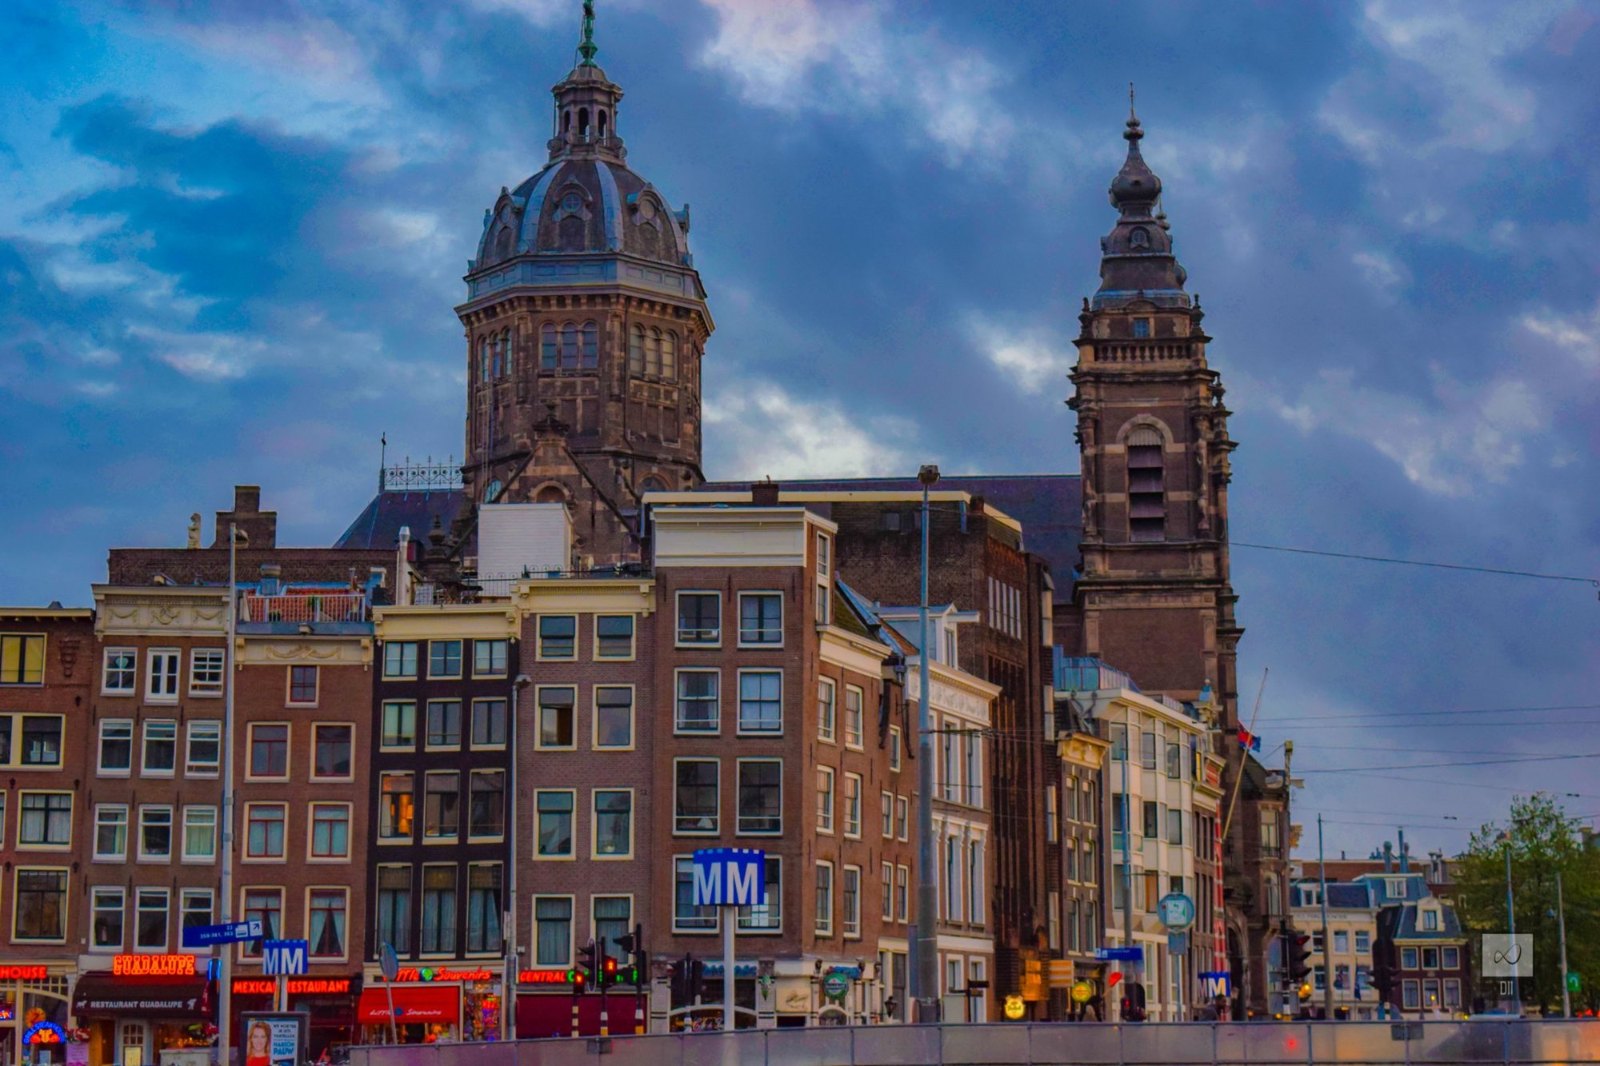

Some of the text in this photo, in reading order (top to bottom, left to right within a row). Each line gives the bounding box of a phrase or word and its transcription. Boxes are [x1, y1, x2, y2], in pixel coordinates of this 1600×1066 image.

[113, 955, 195, 975] GUADALUPE
[519, 971, 567, 983] CENTRAL
[233, 981, 276, 993] MEXICA
[90, 1001, 182, 1009] RESTAURANT GUADALUPE
